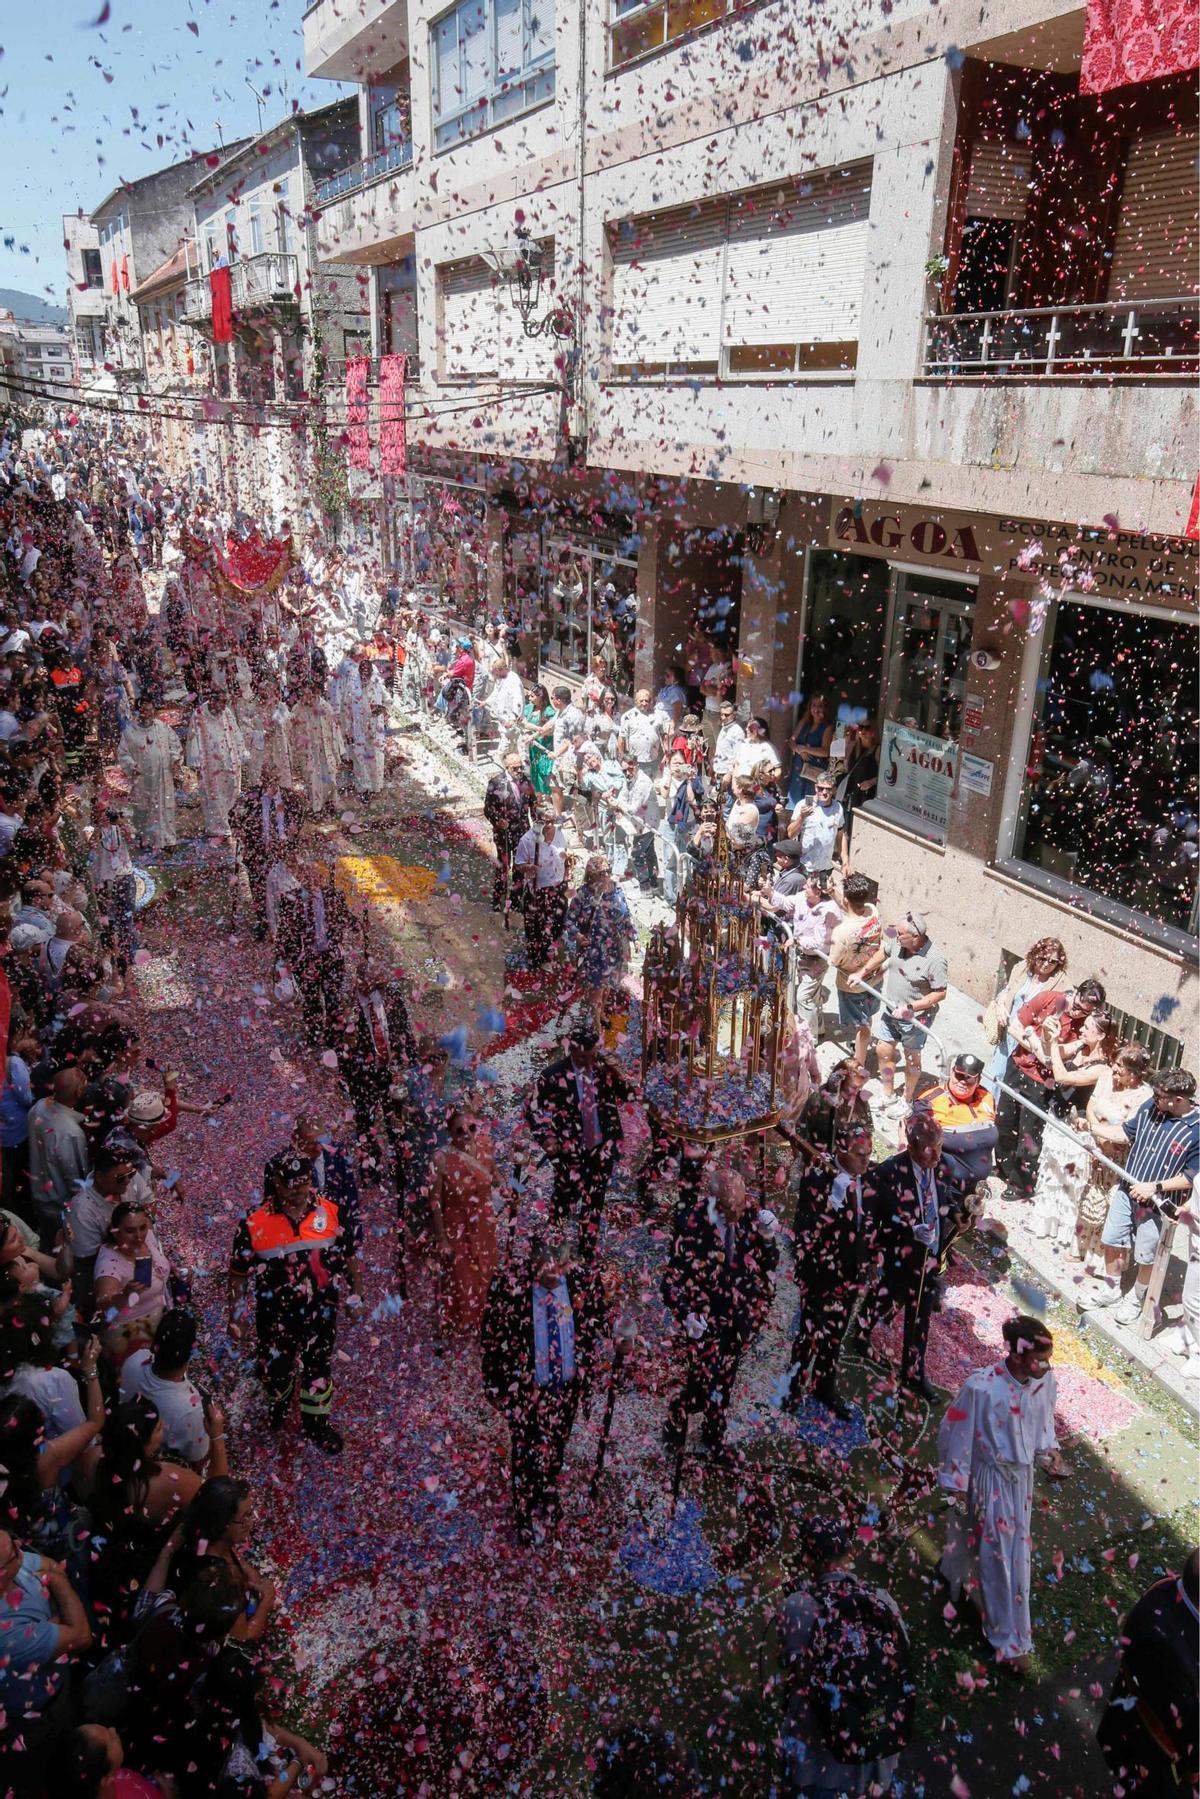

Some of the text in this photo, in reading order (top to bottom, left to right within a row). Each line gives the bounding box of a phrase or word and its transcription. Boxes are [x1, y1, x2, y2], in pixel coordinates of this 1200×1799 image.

[834, 507, 984, 562] AGOA
[999, 518, 1069, 541] ESCOLA
[1081, 528, 1106, 545] DE
[1149, 558, 1176, 576] DE
[907, 747, 954, 779] AGOA
